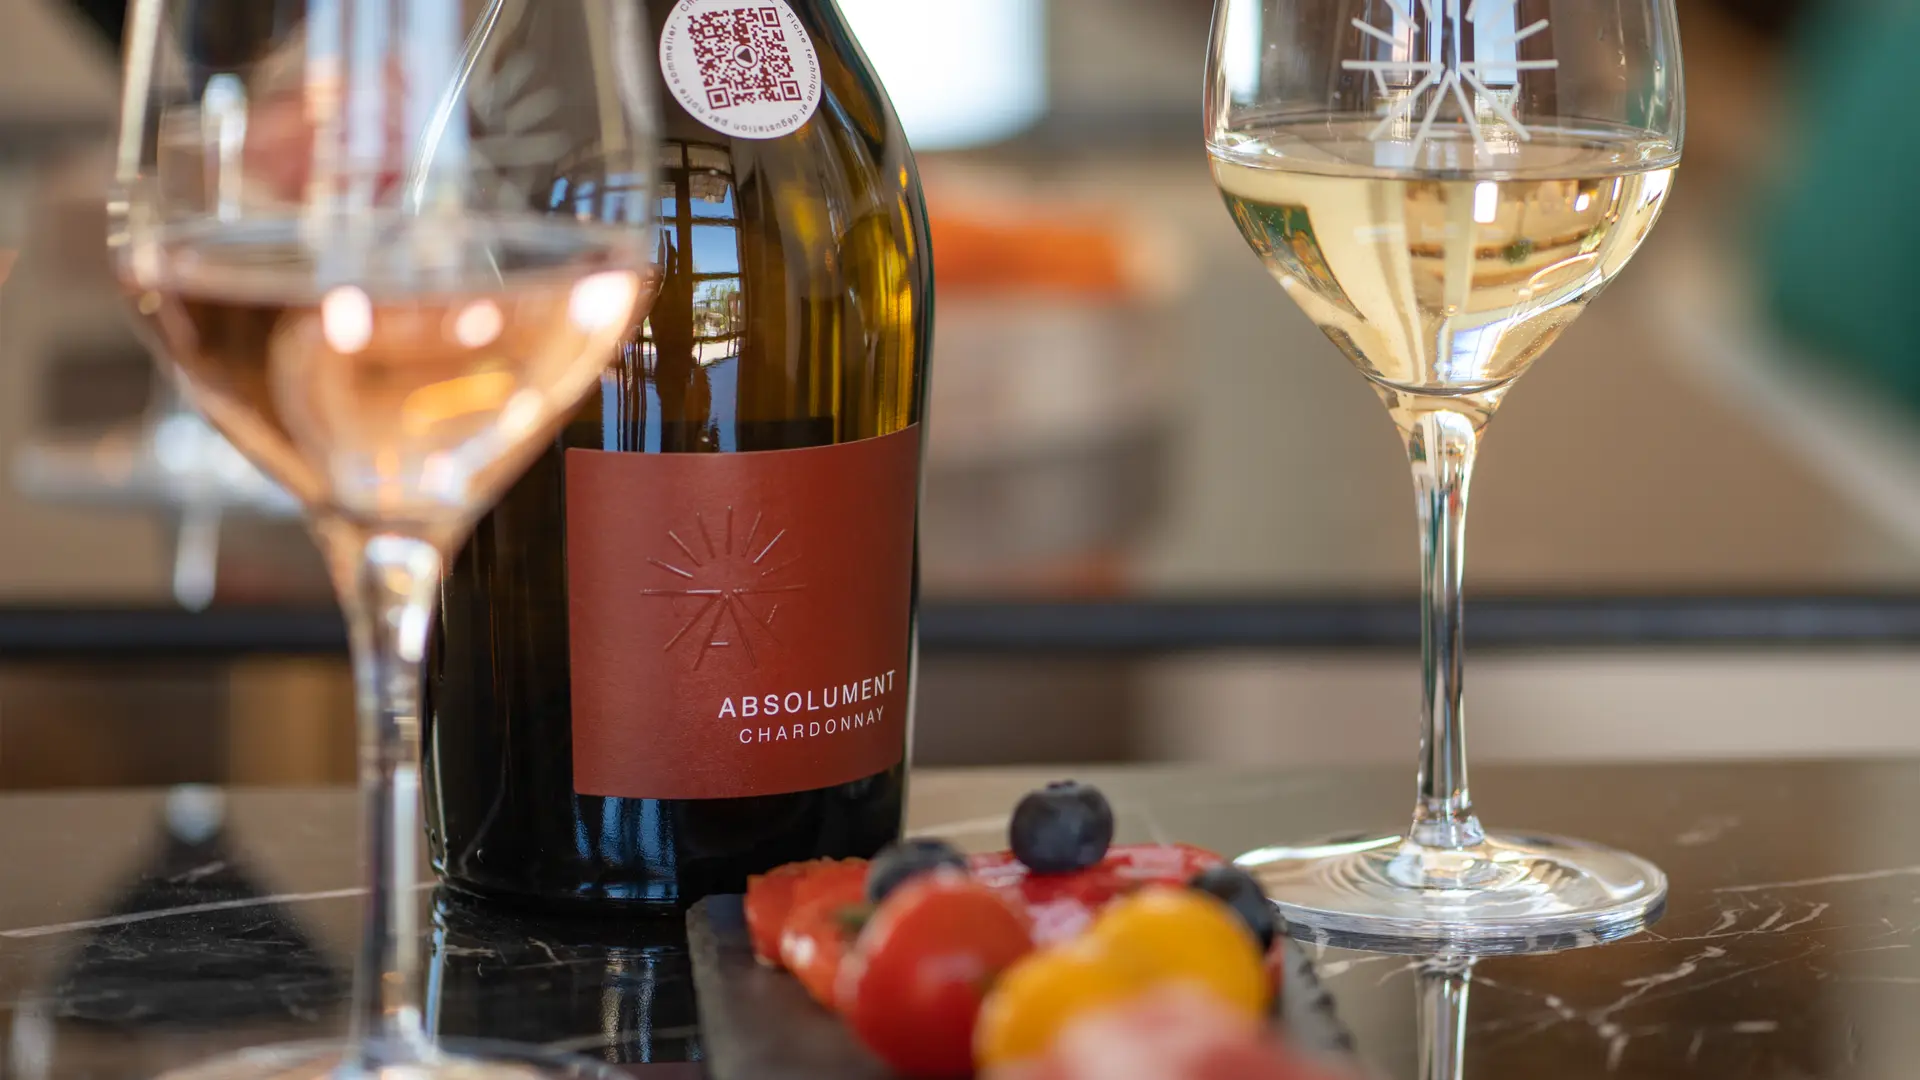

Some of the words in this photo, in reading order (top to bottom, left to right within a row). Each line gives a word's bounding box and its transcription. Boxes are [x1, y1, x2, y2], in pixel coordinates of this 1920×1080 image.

[787, 13, 806, 43] Fiche
[664, 24, 680, 84] sommelier
[805, 48, 818, 101] technique
[680, 88, 704, 114] notre
[799, 104, 808, 115] et
[708, 114, 728, 127] par
[733, 114, 799, 133] dégustation
[718, 669, 896, 719] ABSOLUMENT
[739, 705, 884, 744] CHARDONNAY
